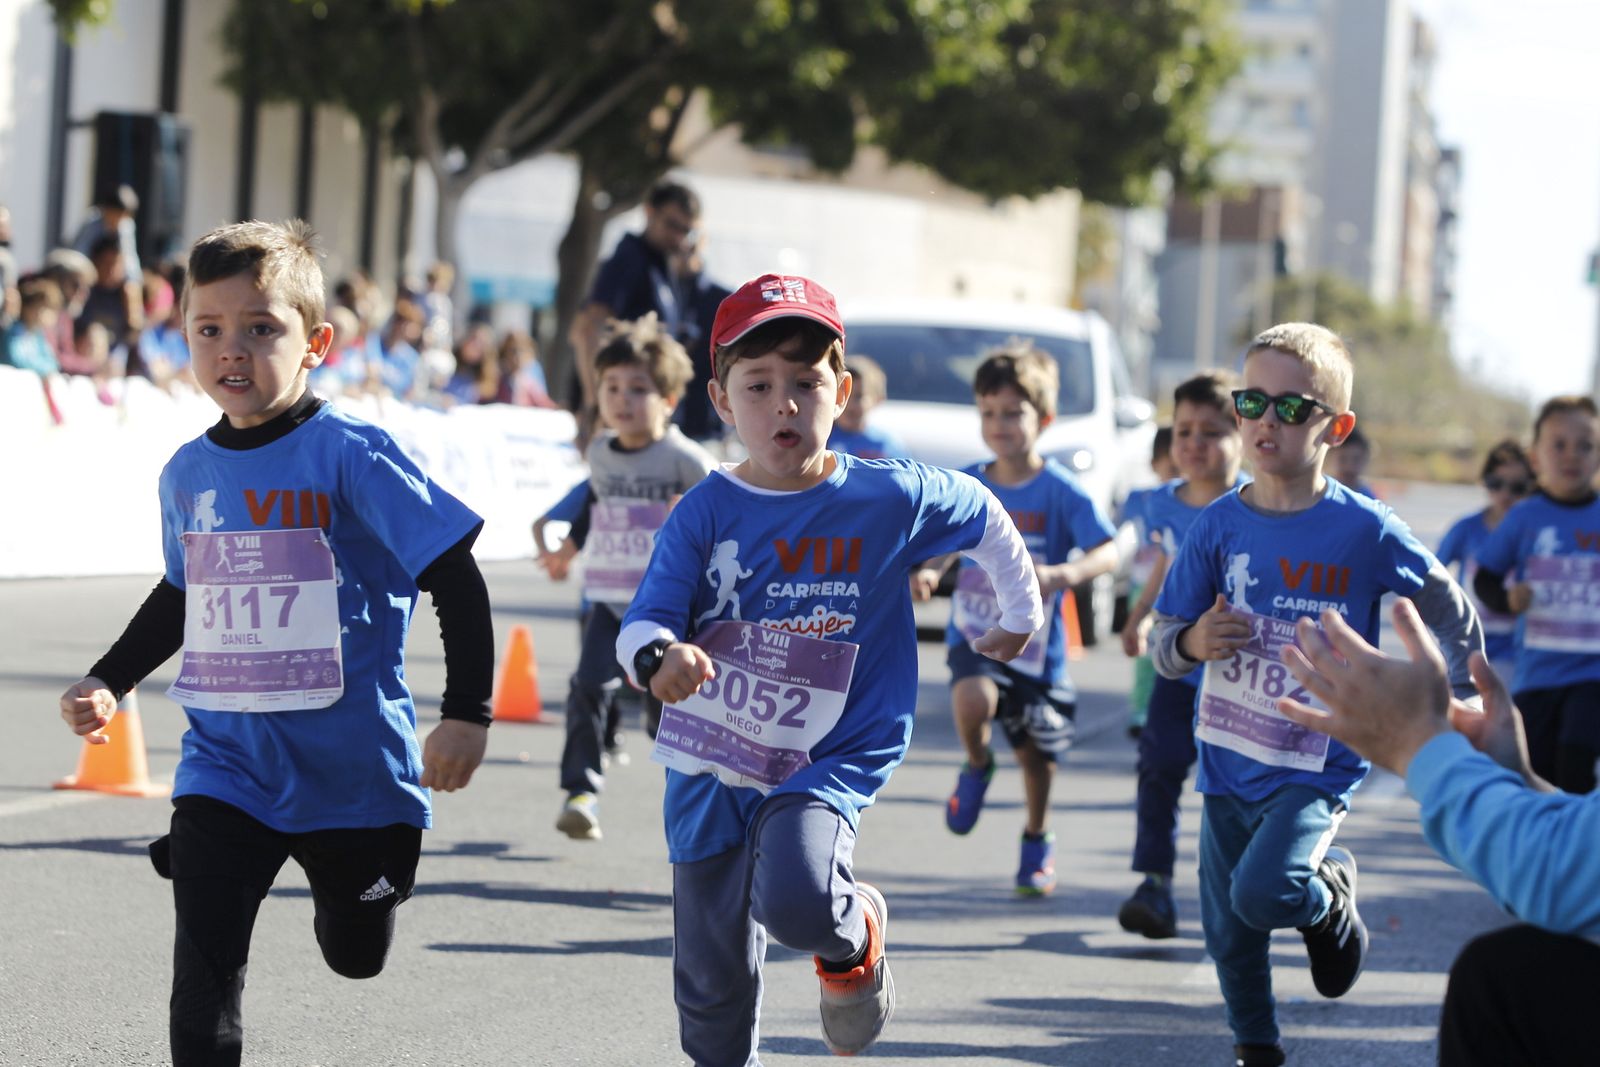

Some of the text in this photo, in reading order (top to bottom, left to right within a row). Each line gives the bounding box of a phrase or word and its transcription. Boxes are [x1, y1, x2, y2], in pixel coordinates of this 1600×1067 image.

[243, 488, 332, 529] VIII
[234, 535, 261, 549] VIII
[773, 537, 863, 574] VIII
[1279, 557, 1351, 596] VIII
[766, 581, 860, 599] CARRERA
[201, 584, 300, 630] 3117
[1273, 595, 1349, 615] CARRERA
[221, 633, 262, 645] DANIEL
[761, 629, 791, 649] VIII
[1272, 621, 1296, 637] VIII
[758, 644, 789, 657] CARRERA
[747, 664, 756, 672] ES
[756, 667, 790, 681] NUESTRA
[790, 676, 811, 685] META
[1222, 649, 1311, 706] 3182
[699, 660, 812, 729] 3052
[726, 711, 763, 736] DIEGO
[360, 886, 395, 901] adidas
